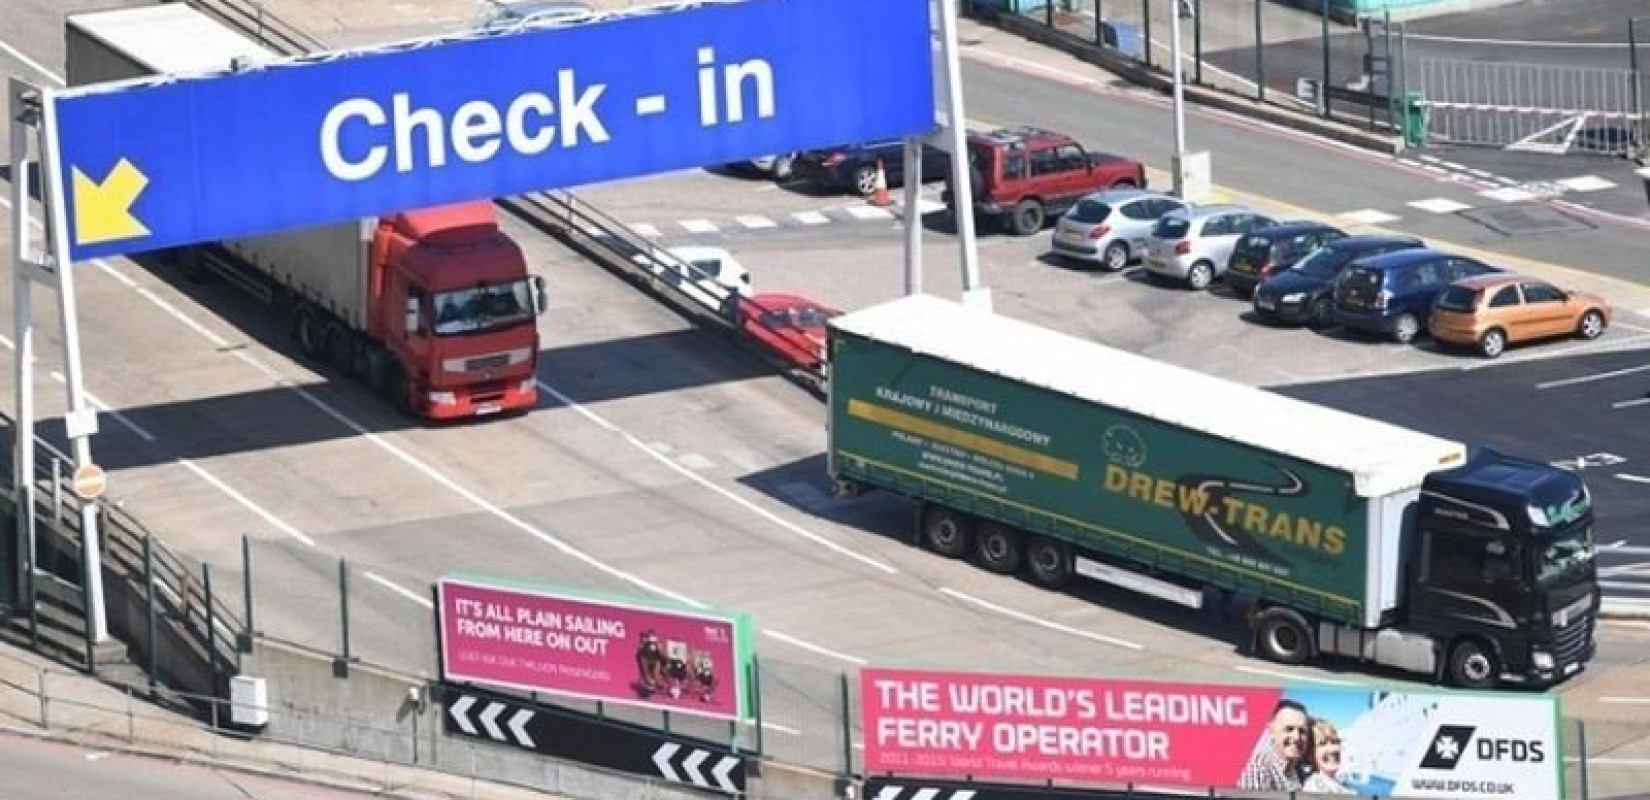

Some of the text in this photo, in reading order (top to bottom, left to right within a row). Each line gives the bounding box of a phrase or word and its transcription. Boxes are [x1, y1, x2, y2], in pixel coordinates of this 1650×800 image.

[321, 69, 611, 181] Check
[697, 47, 775, 126] in
[929, 385, 996, 414] TRANSPORT
[1104, 464, 1346, 554] DREW-TRANS
[455, 598, 625, 638] IT'S ALL PLAIN SAILING
[457, 618, 608, 656] FROM HERE ON OUT
[876, 680, 1248, 727] THE WORLD'S LEADING
[877, 717, 1170, 760] FERRY OPERATOR
[1477, 738, 1545, 762] DFDS
